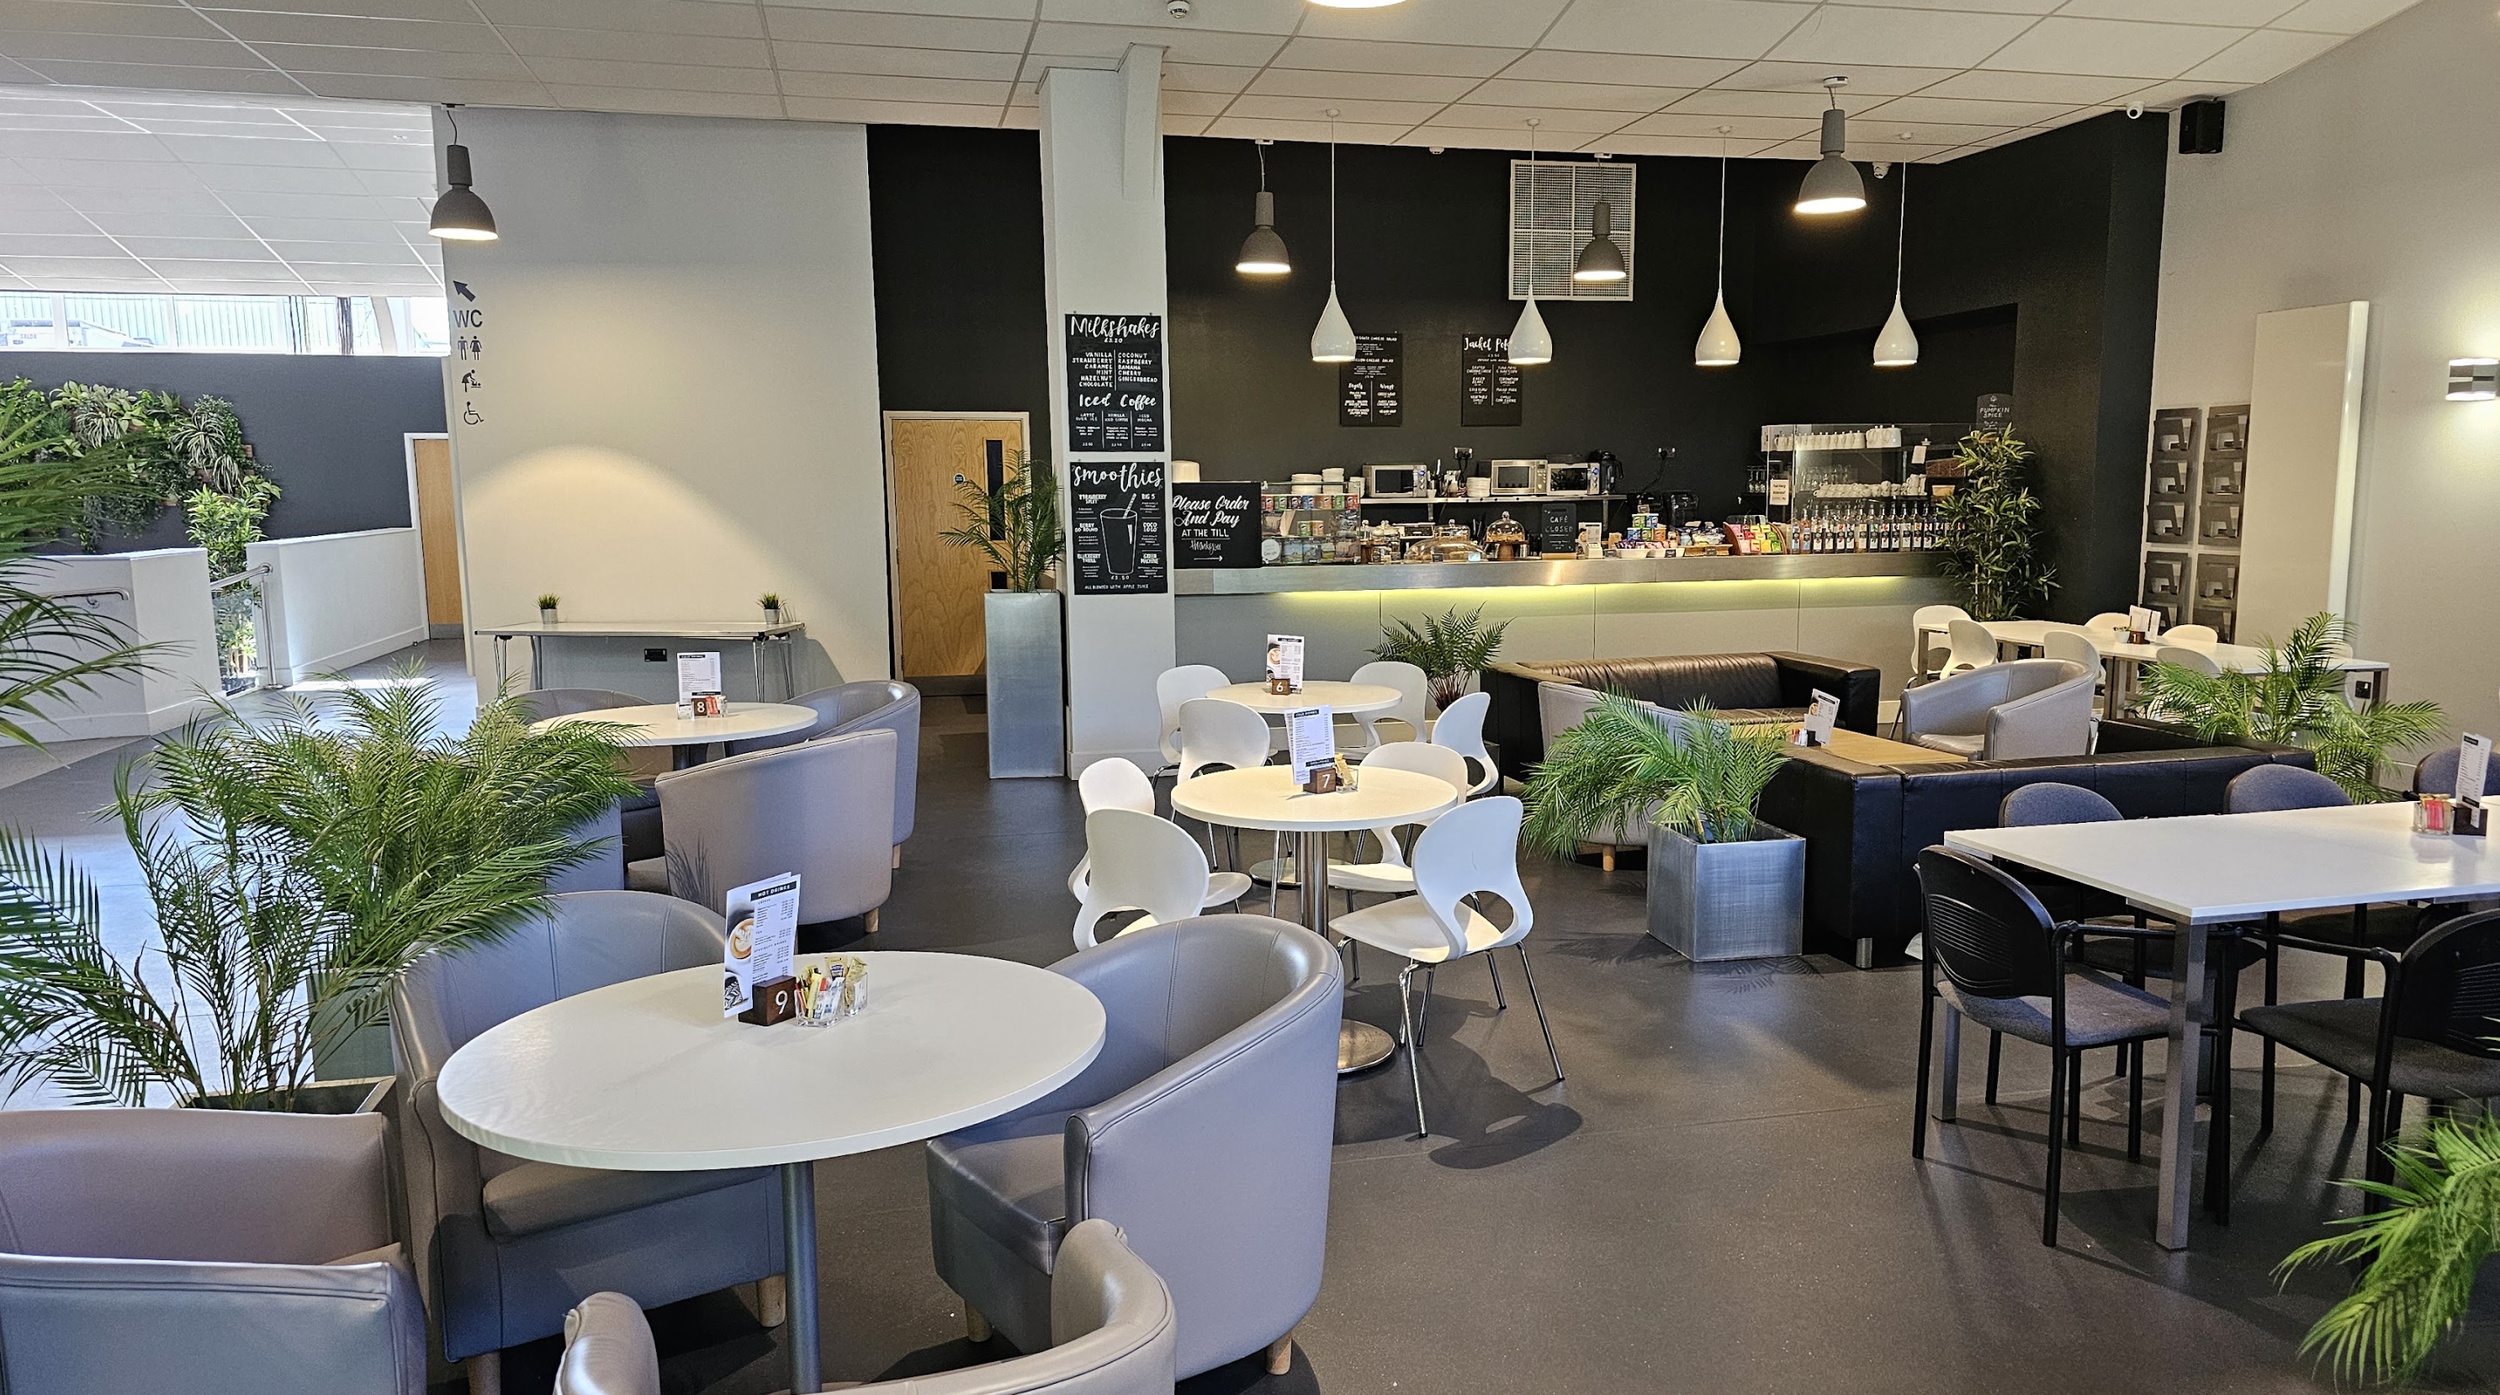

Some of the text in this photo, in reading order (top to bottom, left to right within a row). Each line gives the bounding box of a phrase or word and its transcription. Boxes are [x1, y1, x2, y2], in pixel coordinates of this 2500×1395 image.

[453, 309, 483, 328] WC
[1071, 316, 1160, 338] Milkshakes
[1079, 393, 1157, 411] Iced Coffee
[1073, 462, 1164, 492] Smoothies
[1172, 494, 1212, 511] Please
[1214, 495, 1250, 511] Order
[1174, 510, 1240, 528] And Pay
[1181, 528, 1229, 537] AT THE TILL
[1276, 682, 1284, 692] 6
[697, 701, 705, 713] 8
[1322, 773, 1331, 788] 7
[757, 884, 790, 898] HOT DRINKS
[775, 990, 788, 1015] 9
